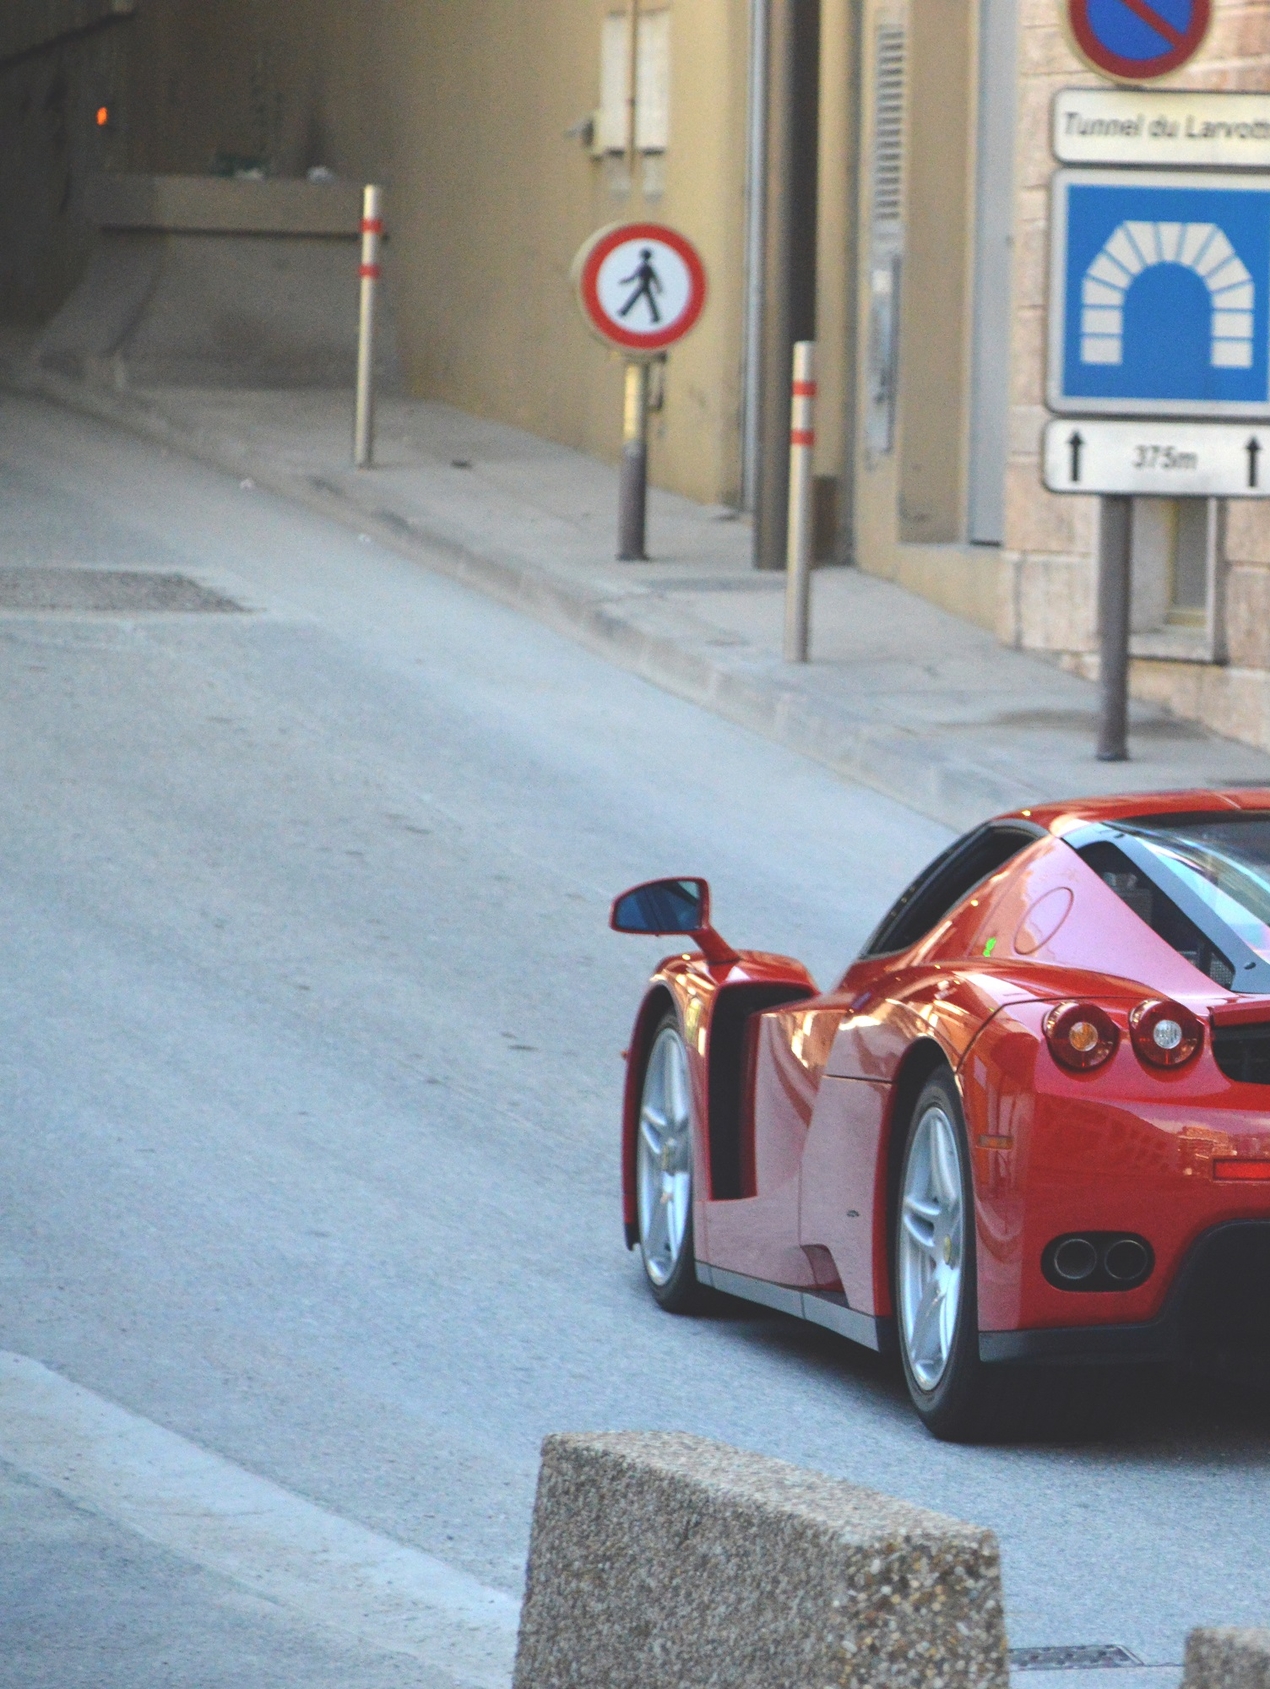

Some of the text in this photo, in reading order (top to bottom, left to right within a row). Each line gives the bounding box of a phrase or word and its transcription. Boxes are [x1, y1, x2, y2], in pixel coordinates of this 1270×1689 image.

[1065, 111, 1144, 137] Tunnel
[1149, 114, 1179, 138] du
[1133, 445, 1198, 471] 375m
